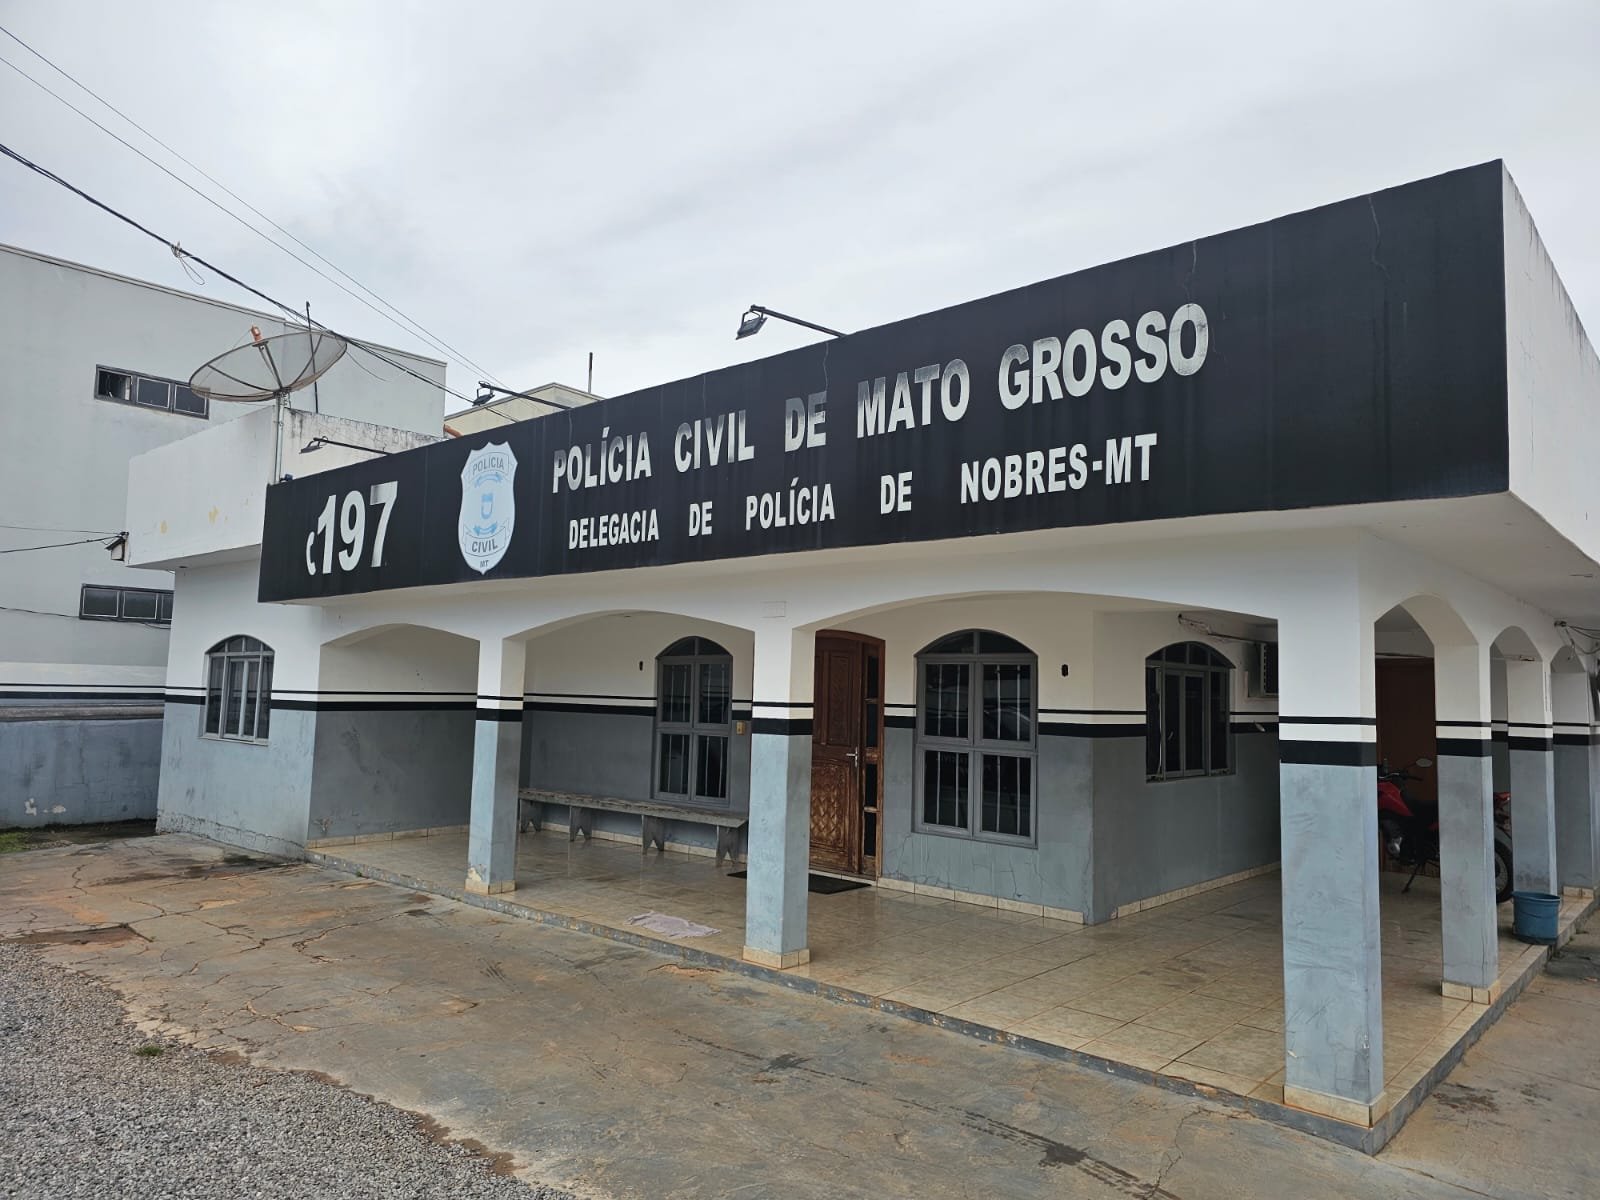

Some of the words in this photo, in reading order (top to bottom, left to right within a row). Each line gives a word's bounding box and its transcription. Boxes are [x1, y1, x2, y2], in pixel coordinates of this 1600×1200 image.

[552, 426, 652, 494] POLÍCIA
[674, 410, 755, 473] CIVIL
[785, 391, 827, 453] DE
[857, 359, 970, 438] MATO
[999, 303, 1209, 410] GROSSO
[316, 481, 399, 575] 197
[568, 509, 660, 550] DELEGACIA
[689, 501, 713, 537] DE
[746, 477, 836, 531] POLÍCIA
[881, 471, 913, 515] DE
[961, 433, 1158, 504] NOBRES-MT
[471, 539, 498, 553] CIVIL
[479, 560, 489, 568] MT
